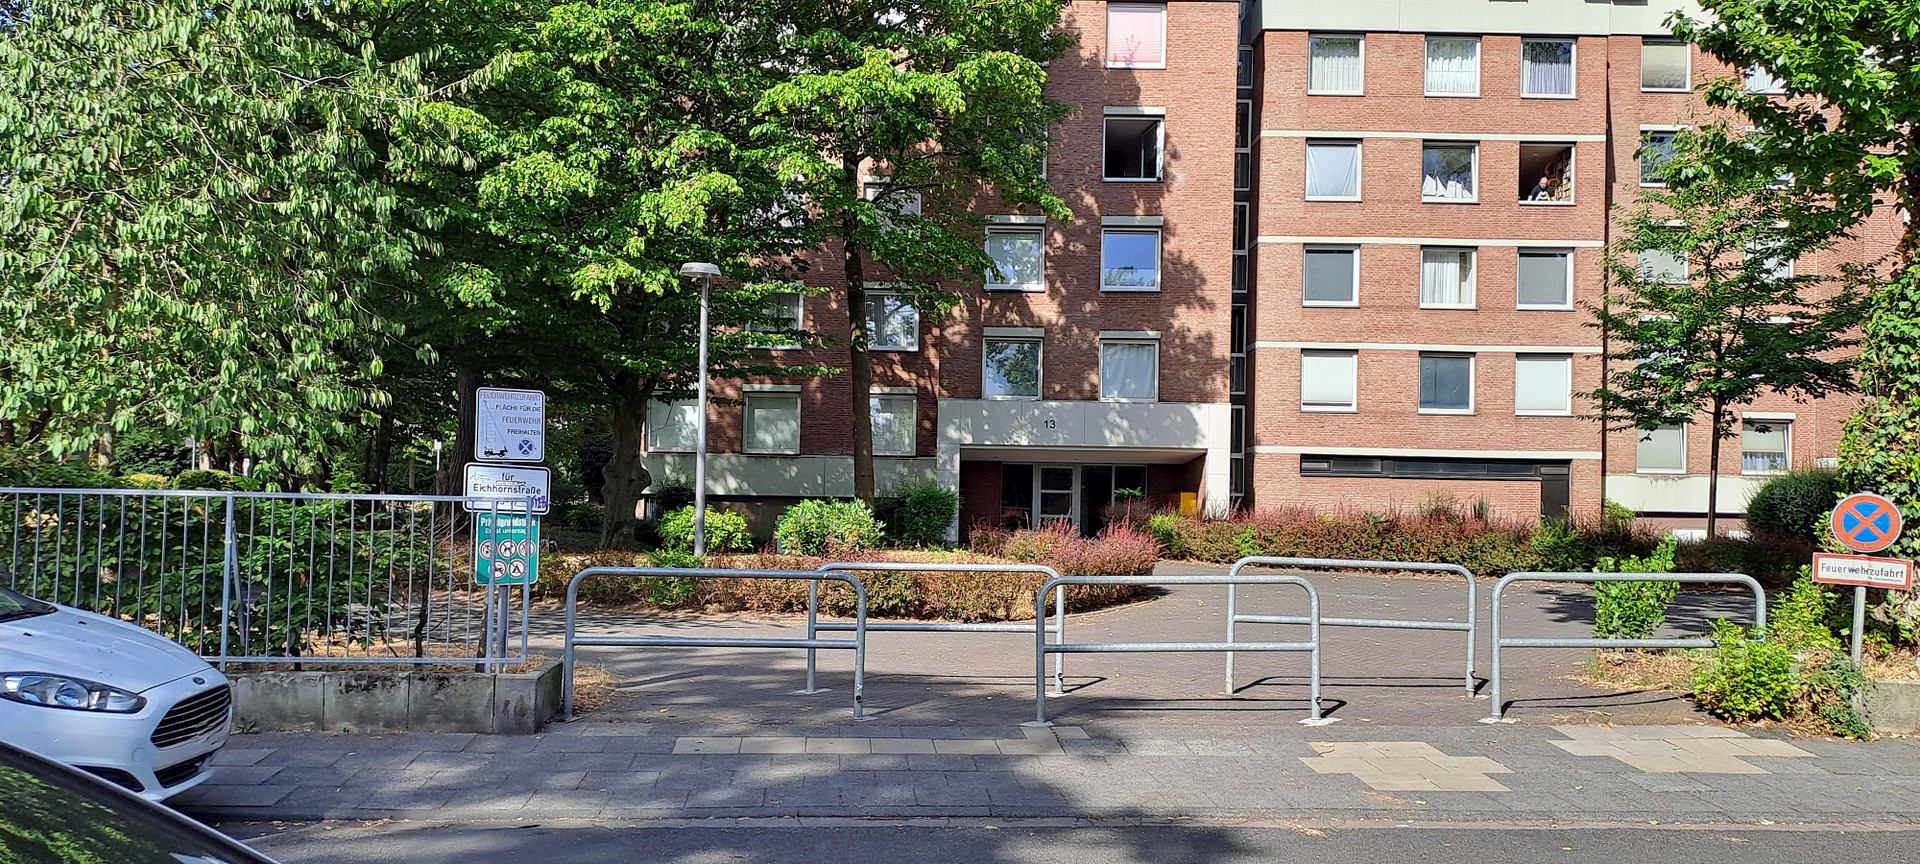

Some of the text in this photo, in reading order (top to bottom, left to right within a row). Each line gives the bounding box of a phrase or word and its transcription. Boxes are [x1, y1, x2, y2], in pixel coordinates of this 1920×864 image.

[480, 391, 541, 402] FEUERWEHRZUFAHRT
[519, 404, 532, 412] FÜR
[502, 416, 541, 425] FEUERWEHR
[1043, 419, 1056, 429] 13
[501, 472, 515, 481] für
[473, 483, 541, 495] Eichhornstraße
[1821, 563, 1904, 578] Feuerwehrzufahrt
